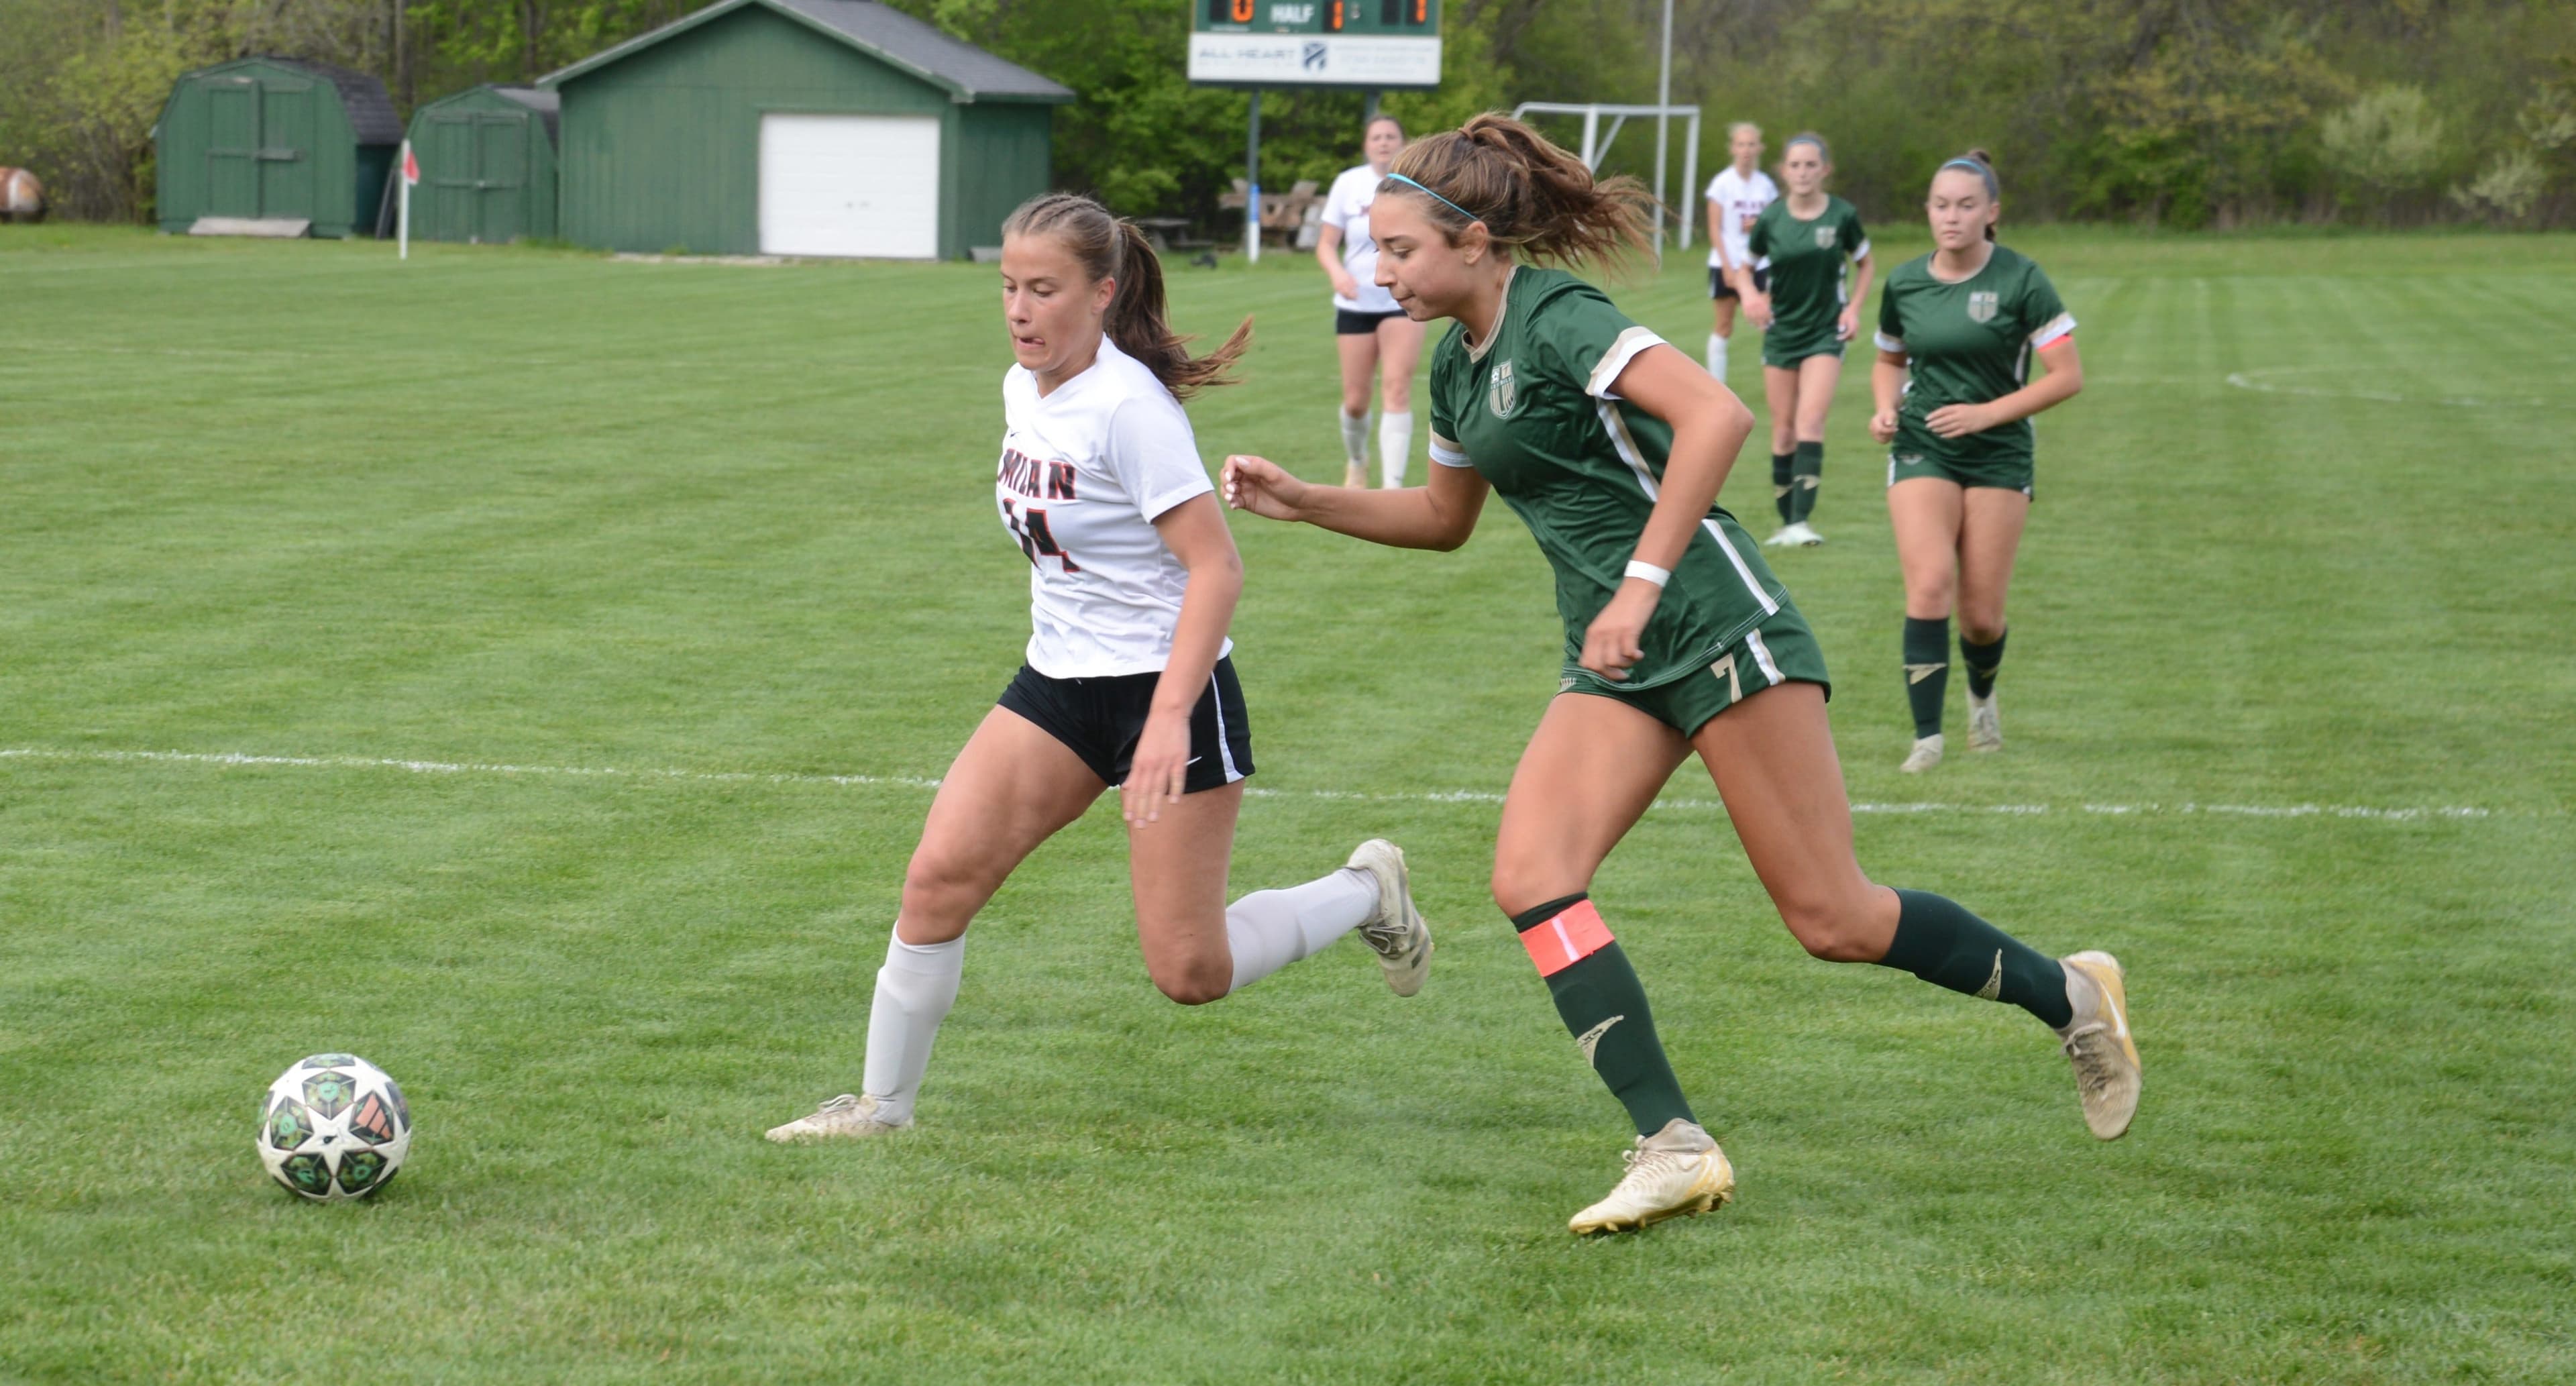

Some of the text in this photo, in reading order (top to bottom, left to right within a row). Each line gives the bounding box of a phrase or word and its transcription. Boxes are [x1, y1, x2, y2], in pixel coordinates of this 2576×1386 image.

[1271, 3, 1315, 23] HALF
[1199, 48, 1295, 59] ALL HEART
[998, 448, 1077, 500] MILAN
[1711, 653, 1743, 703] 7
